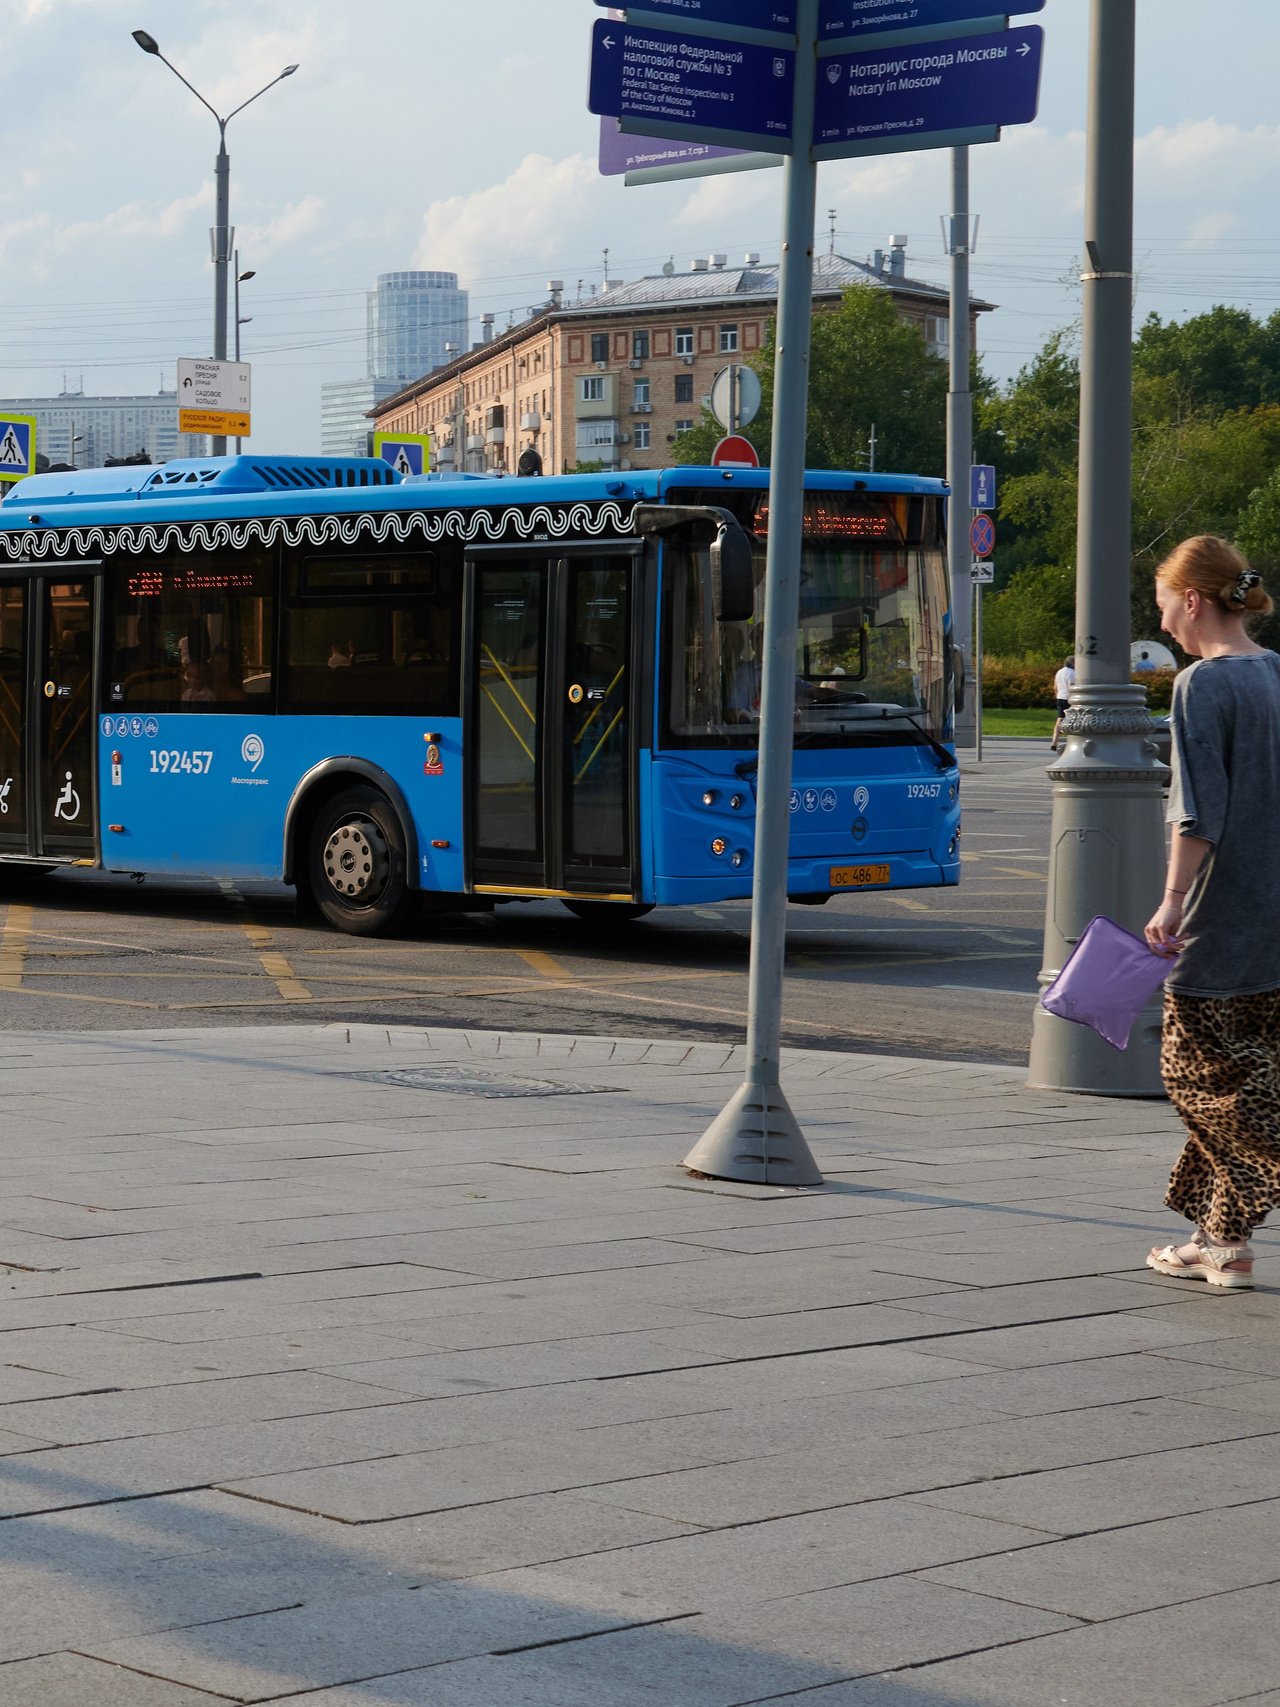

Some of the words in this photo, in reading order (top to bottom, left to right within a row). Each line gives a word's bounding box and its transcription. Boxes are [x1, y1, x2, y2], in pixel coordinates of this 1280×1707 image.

[777, 15, 789, 23] min
[825, 22, 831, 30] 6
[831, 21, 844, 29] min
[851, 19, 861, 28] ул.
[910, 9, 918, 18] 27
[624, 35, 678, 54] Инспекция
[679, 42, 743, 64] Федеральной
[623, 51, 674, 68] налоговой
[675, 59, 712, 74] службы
[713, 63, 725, 75] №
[726, 65, 733, 76] 3
[849, 59, 908, 78] Нотариус
[909, 53, 954, 71] города
[956, 46, 1008, 64] Москвы
[623, 66, 634, 77] по
[637, 68, 644, 77] г.
[644, 67, 680, 83] Москве
[622, 78, 648, 89] Federal
[648, 81, 660, 91] Tax
[660, 83, 684, 95] Service
[685, 87, 720, 99] Inspection
[729, 93, 734, 101] 3
[848, 81, 885, 97] Notary
[886, 79, 897, 92] in
[898, 75, 942, 90] Moscow
[621, 89, 631, 98] of
[630, 90, 642, 99] the
[642, 91, 657, 104] City
[657, 94, 666, 102] of
[665, 96, 693, 106] Moscow
[691, 110, 696, 118] 2
[766, 121, 775, 129] 10
[775, 121, 787, 130] min
[826, 128, 840, 136] min
[846, 127, 856, 136] ул.
[856, 123, 883, 134] Красная
[915, 117, 924, 126] 29
[149, 750, 214, 774] 192457
[231, 777, 269, 786] Мосгортранс
[907, 784, 941, 798] 192457
[852, 868, 872, 883] 486
[877, 866, 887, 877] 77
